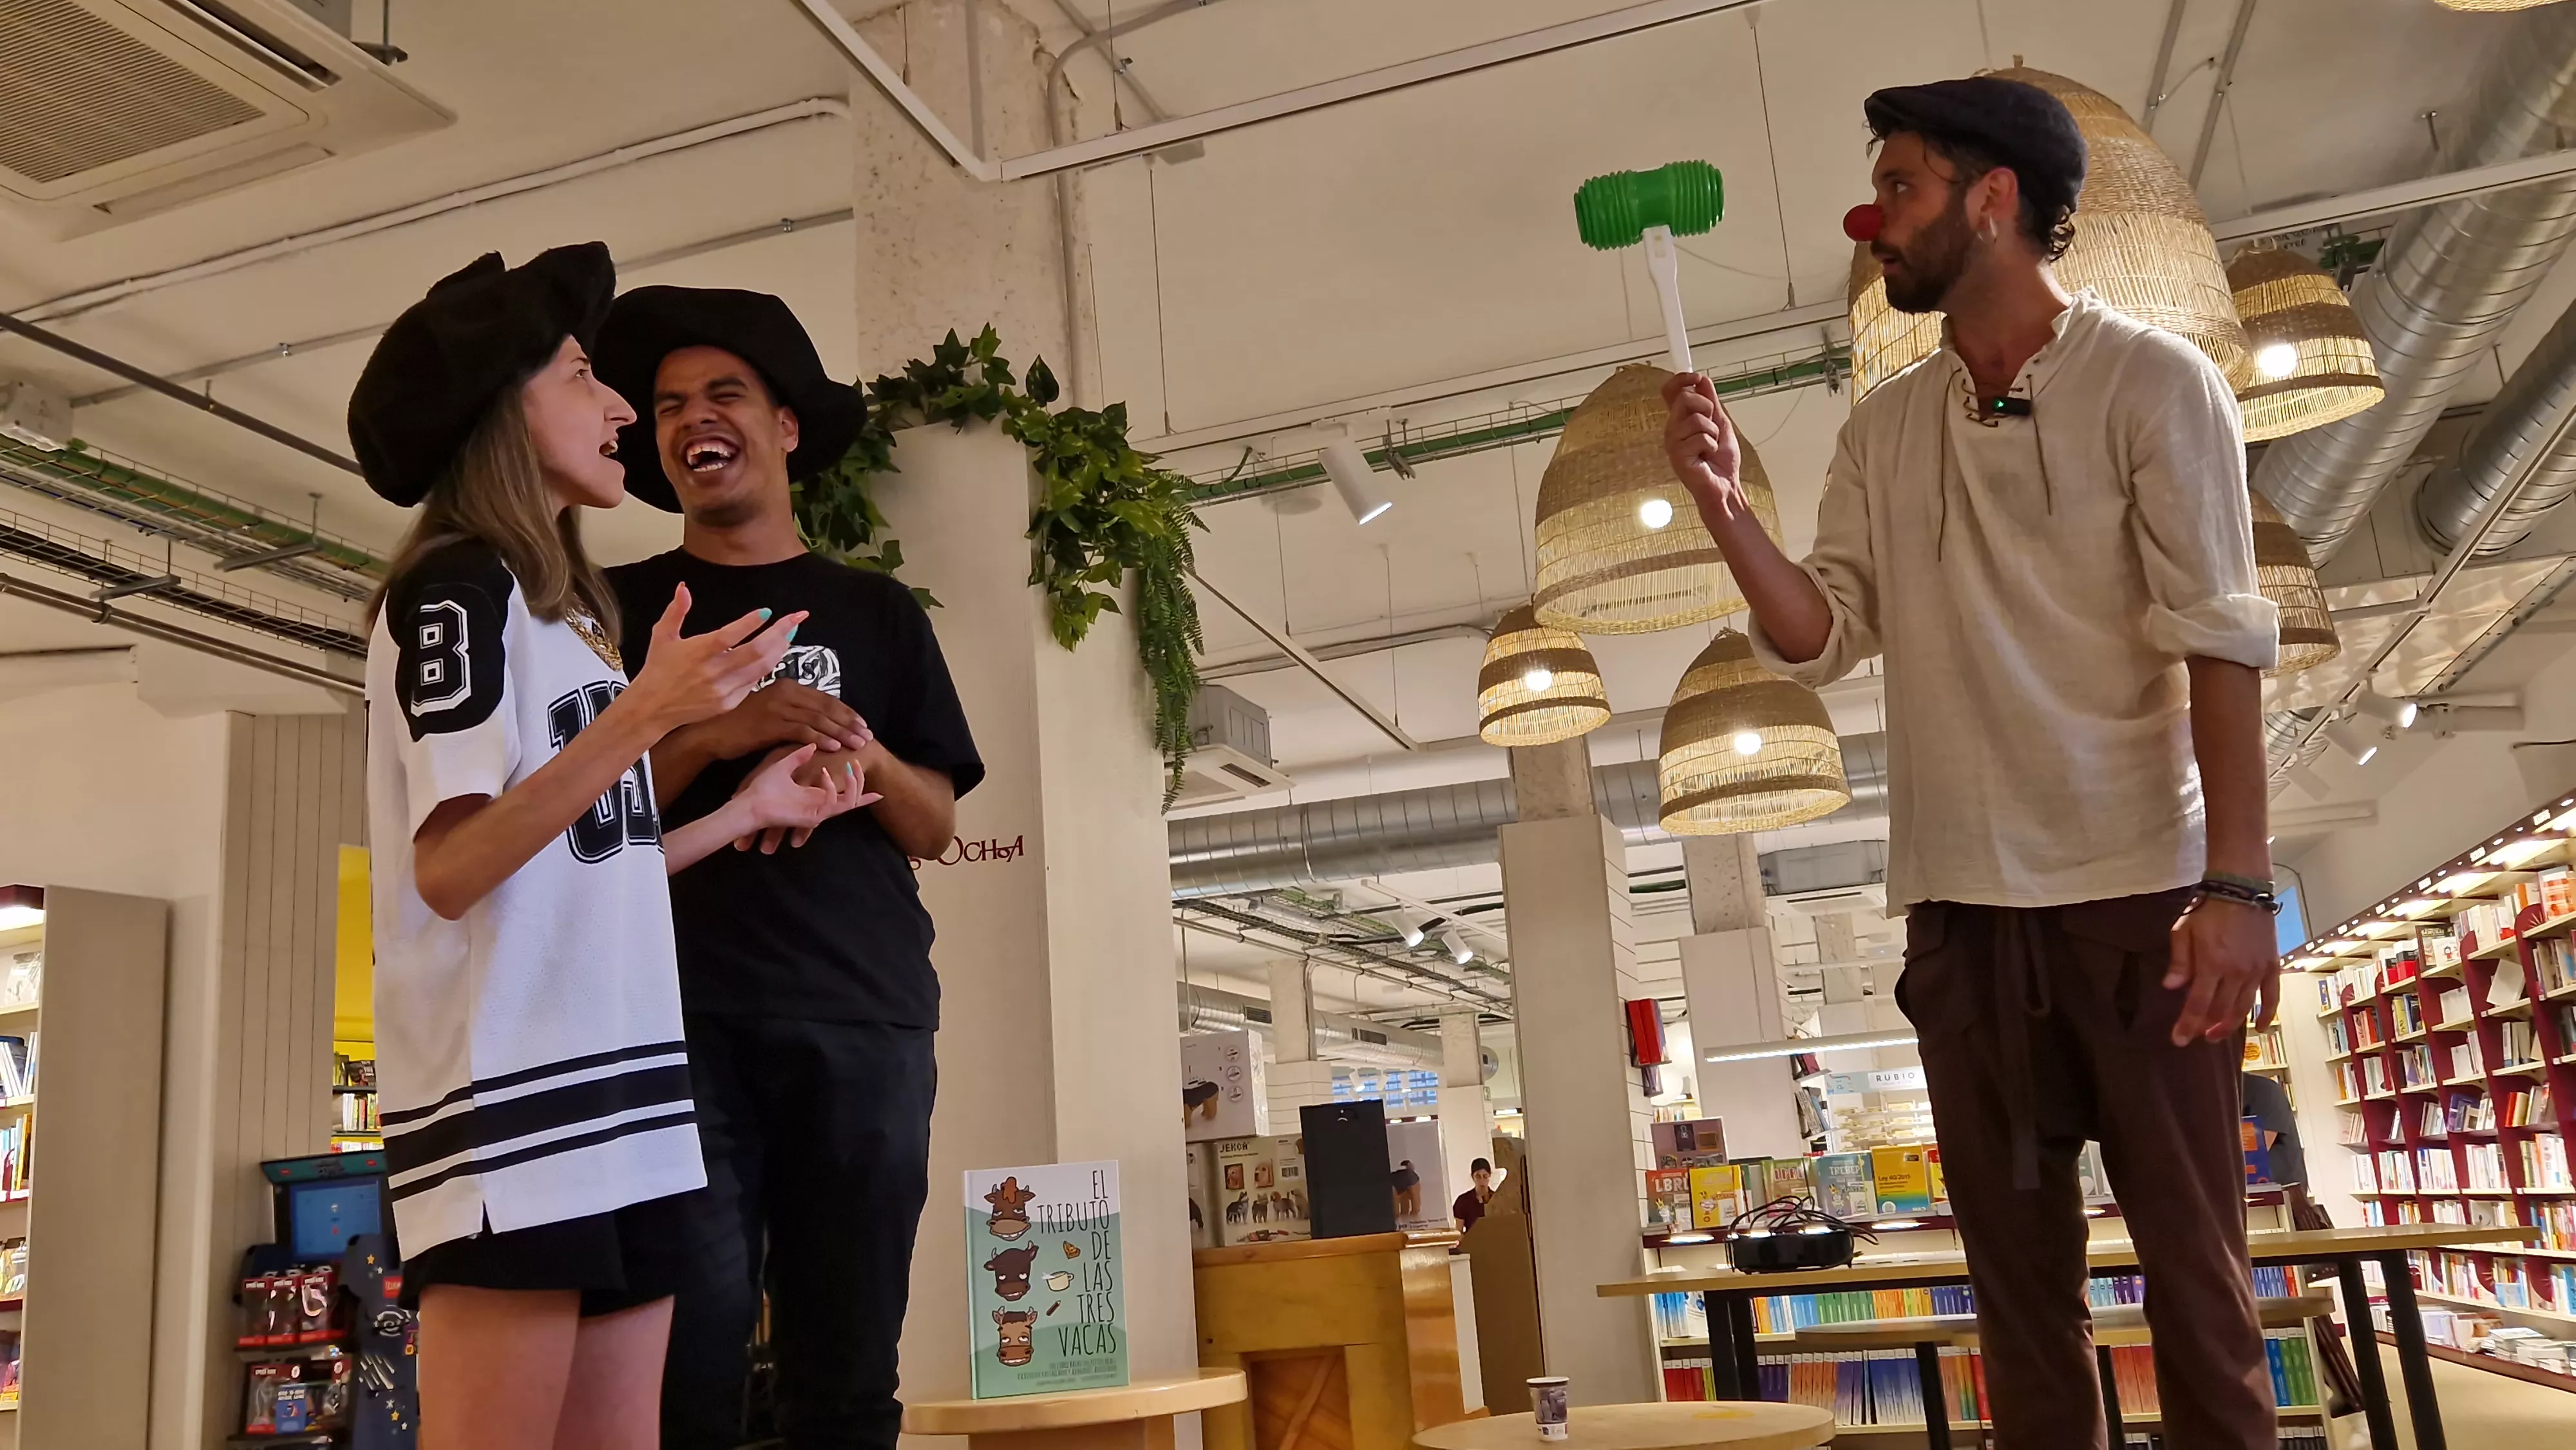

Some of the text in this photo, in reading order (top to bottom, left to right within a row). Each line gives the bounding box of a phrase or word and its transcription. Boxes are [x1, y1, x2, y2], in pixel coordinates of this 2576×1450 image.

[410, 599, 471, 717] 8
[1876, 1072, 1915, 1082] RUBIO
[1093, 1170, 1108, 1200] EL
[1037, 1200, 1110, 1234] TRIBUTO
[1092, 1230, 1112, 1260] DE
[1083, 1261, 1113, 1293] LAS
[1077, 1291, 1115, 1324] TRES
[1058, 1323, 1117, 1357] VACAS
